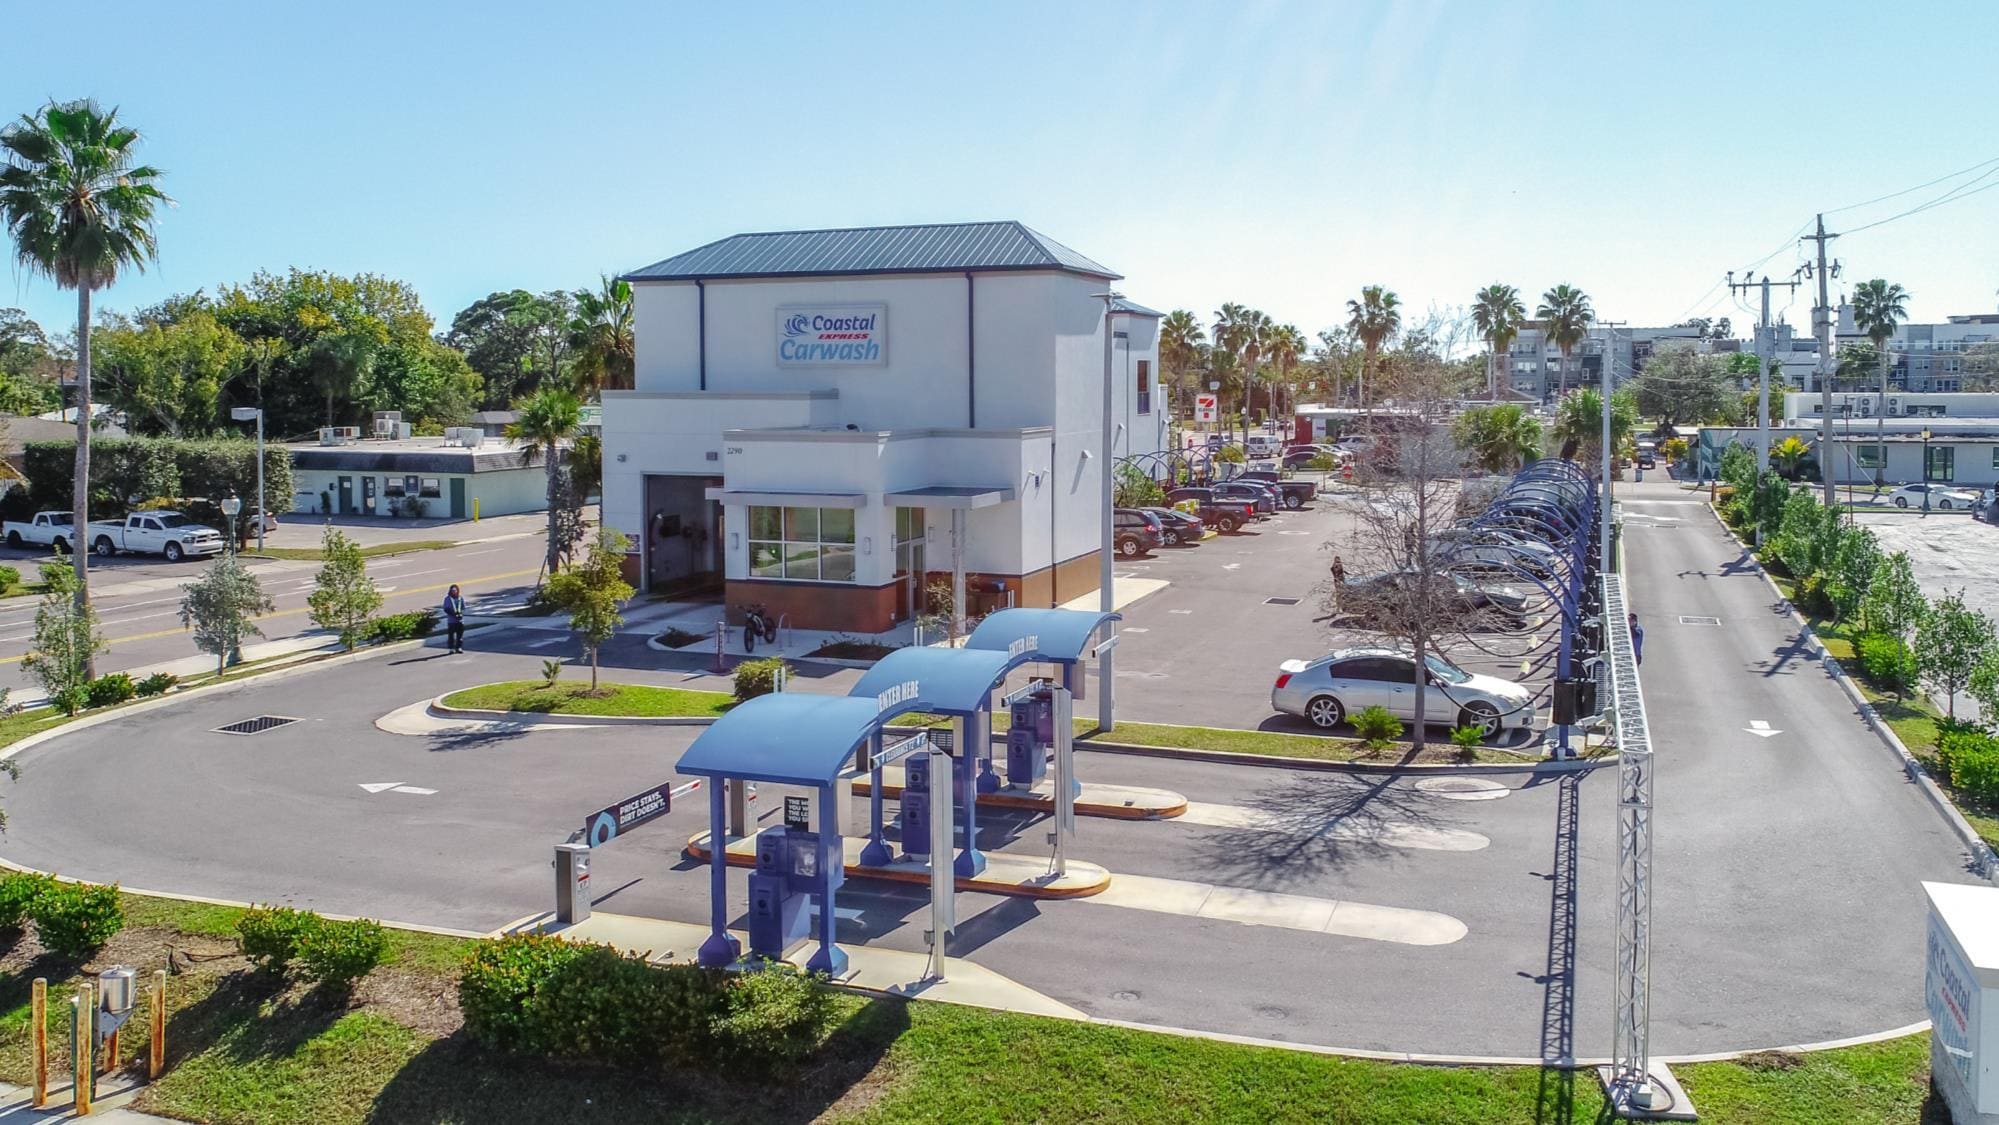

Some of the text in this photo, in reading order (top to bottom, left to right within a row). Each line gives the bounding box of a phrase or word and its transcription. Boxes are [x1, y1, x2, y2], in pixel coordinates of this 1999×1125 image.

[812, 313, 876, 331] Coastal
[780, 339, 879, 360] Carwash
[878, 680, 919, 713] ENTER HERE
[619, 791, 662, 816] PRICE STAYS.
[620, 811, 637, 825] DIRT
[637, 798, 666, 816] DOESN'T.
[1939, 948, 1971, 1021] Coastal
